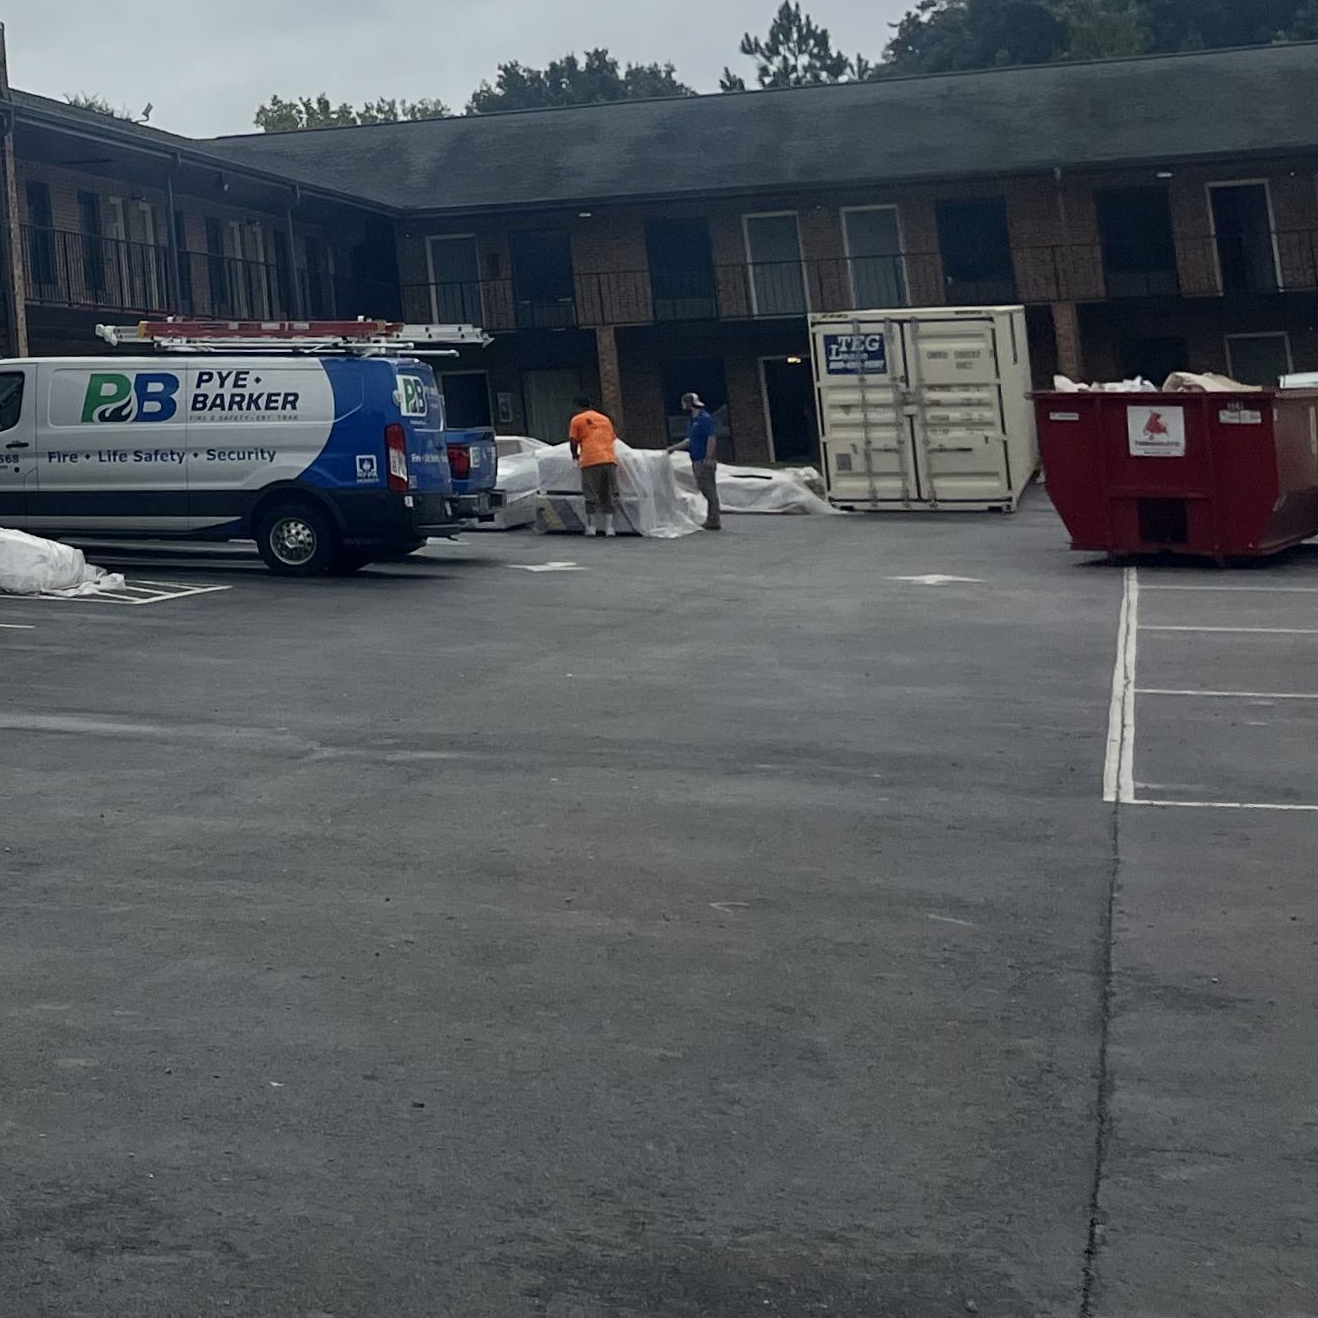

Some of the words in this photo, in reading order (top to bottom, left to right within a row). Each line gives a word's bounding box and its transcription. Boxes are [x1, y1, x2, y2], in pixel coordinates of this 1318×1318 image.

[81, 372, 180, 423] PB
[191, 392, 300, 412] BARKER
[47, 451, 79, 463] Fire
[98, 449, 127, 463] Life
[132, 449, 186, 465] Safety
[206, 447, 277, 463] Security
